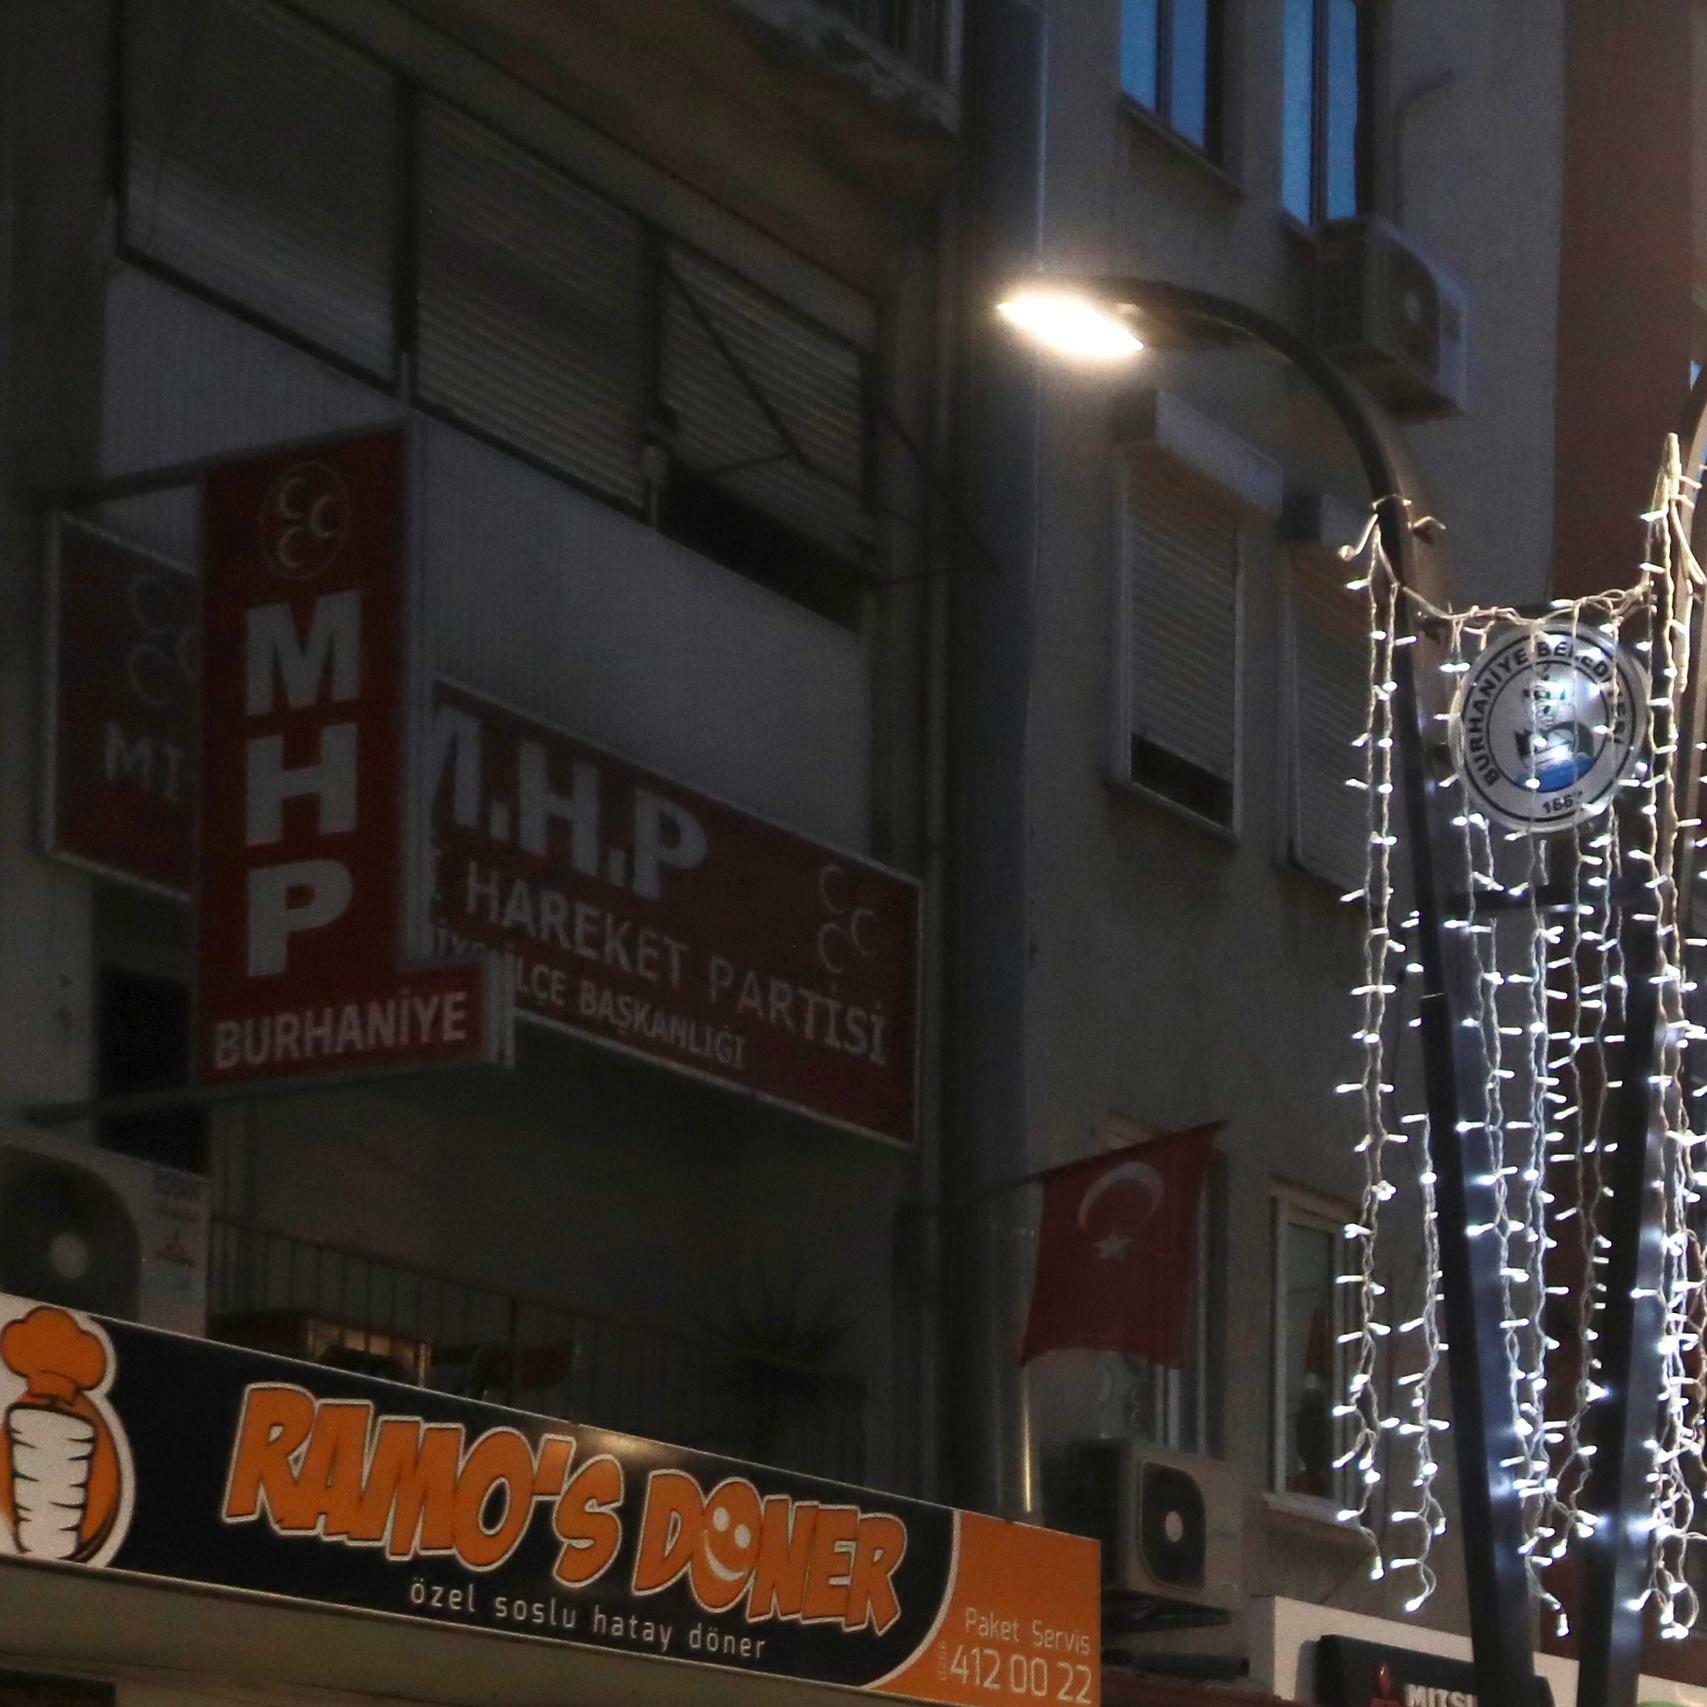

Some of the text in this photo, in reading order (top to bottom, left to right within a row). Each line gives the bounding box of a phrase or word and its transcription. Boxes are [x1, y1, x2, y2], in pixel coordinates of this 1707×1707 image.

[245, 589, 362, 980] MHP
[465, 860, 690, 991] HAREKET
[213, 990, 468, 1070] BURHANİYE
[709, 954, 888, 1067] PARTİSİ
[222, 1381, 624, 1591] RAMO'S
[410, 1576, 767, 1661] özel soslu hatay döner
[965, 1606, 1091, 1656] Paket Servis
[950, 1644, 1001, 1692] 412
[1009, 1652, 1049, 1698] 00
[1056, 1660, 1093, 1704] 22
